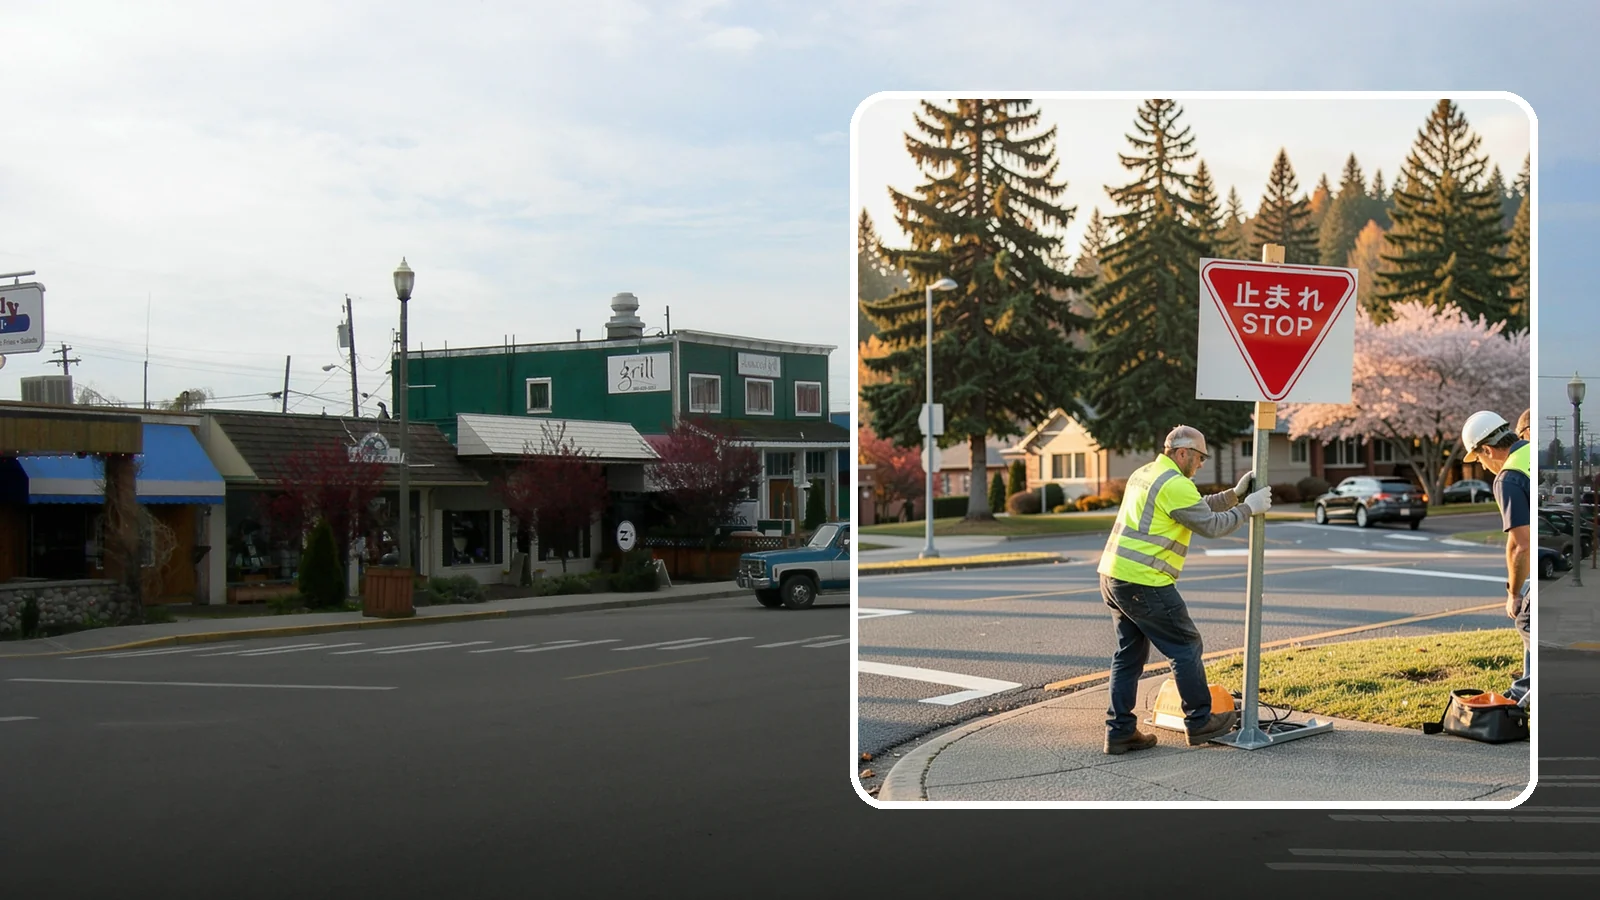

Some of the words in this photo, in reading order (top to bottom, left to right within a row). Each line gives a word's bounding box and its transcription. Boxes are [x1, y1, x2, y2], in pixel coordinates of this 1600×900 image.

[1233, 281, 1324, 311] 止まれ
[1242, 313, 1313, 336] STOP
[20, 337, 38, 345] Salads
[618, 356, 654, 391] grill
